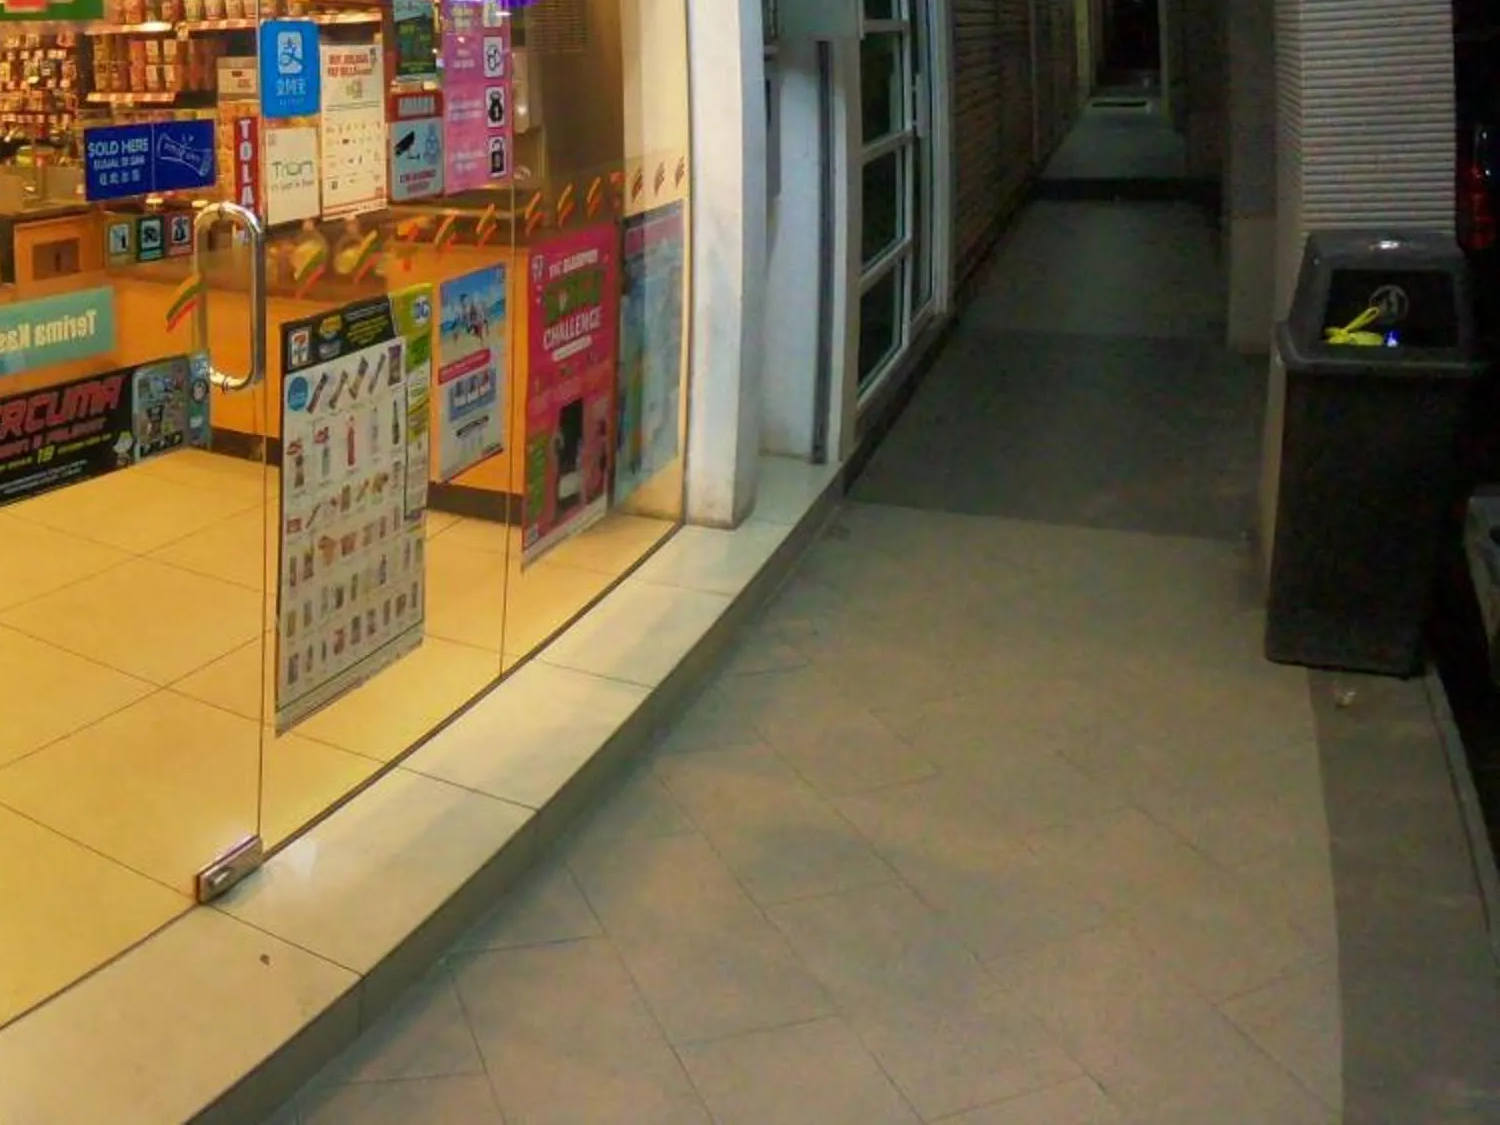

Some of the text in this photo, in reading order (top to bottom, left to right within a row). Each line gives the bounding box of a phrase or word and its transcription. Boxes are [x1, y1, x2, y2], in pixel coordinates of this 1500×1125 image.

[88, 139, 119, 158] SOLD
[121, 137, 149, 156] HERE
[239, 119, 255, 212] TOLA
